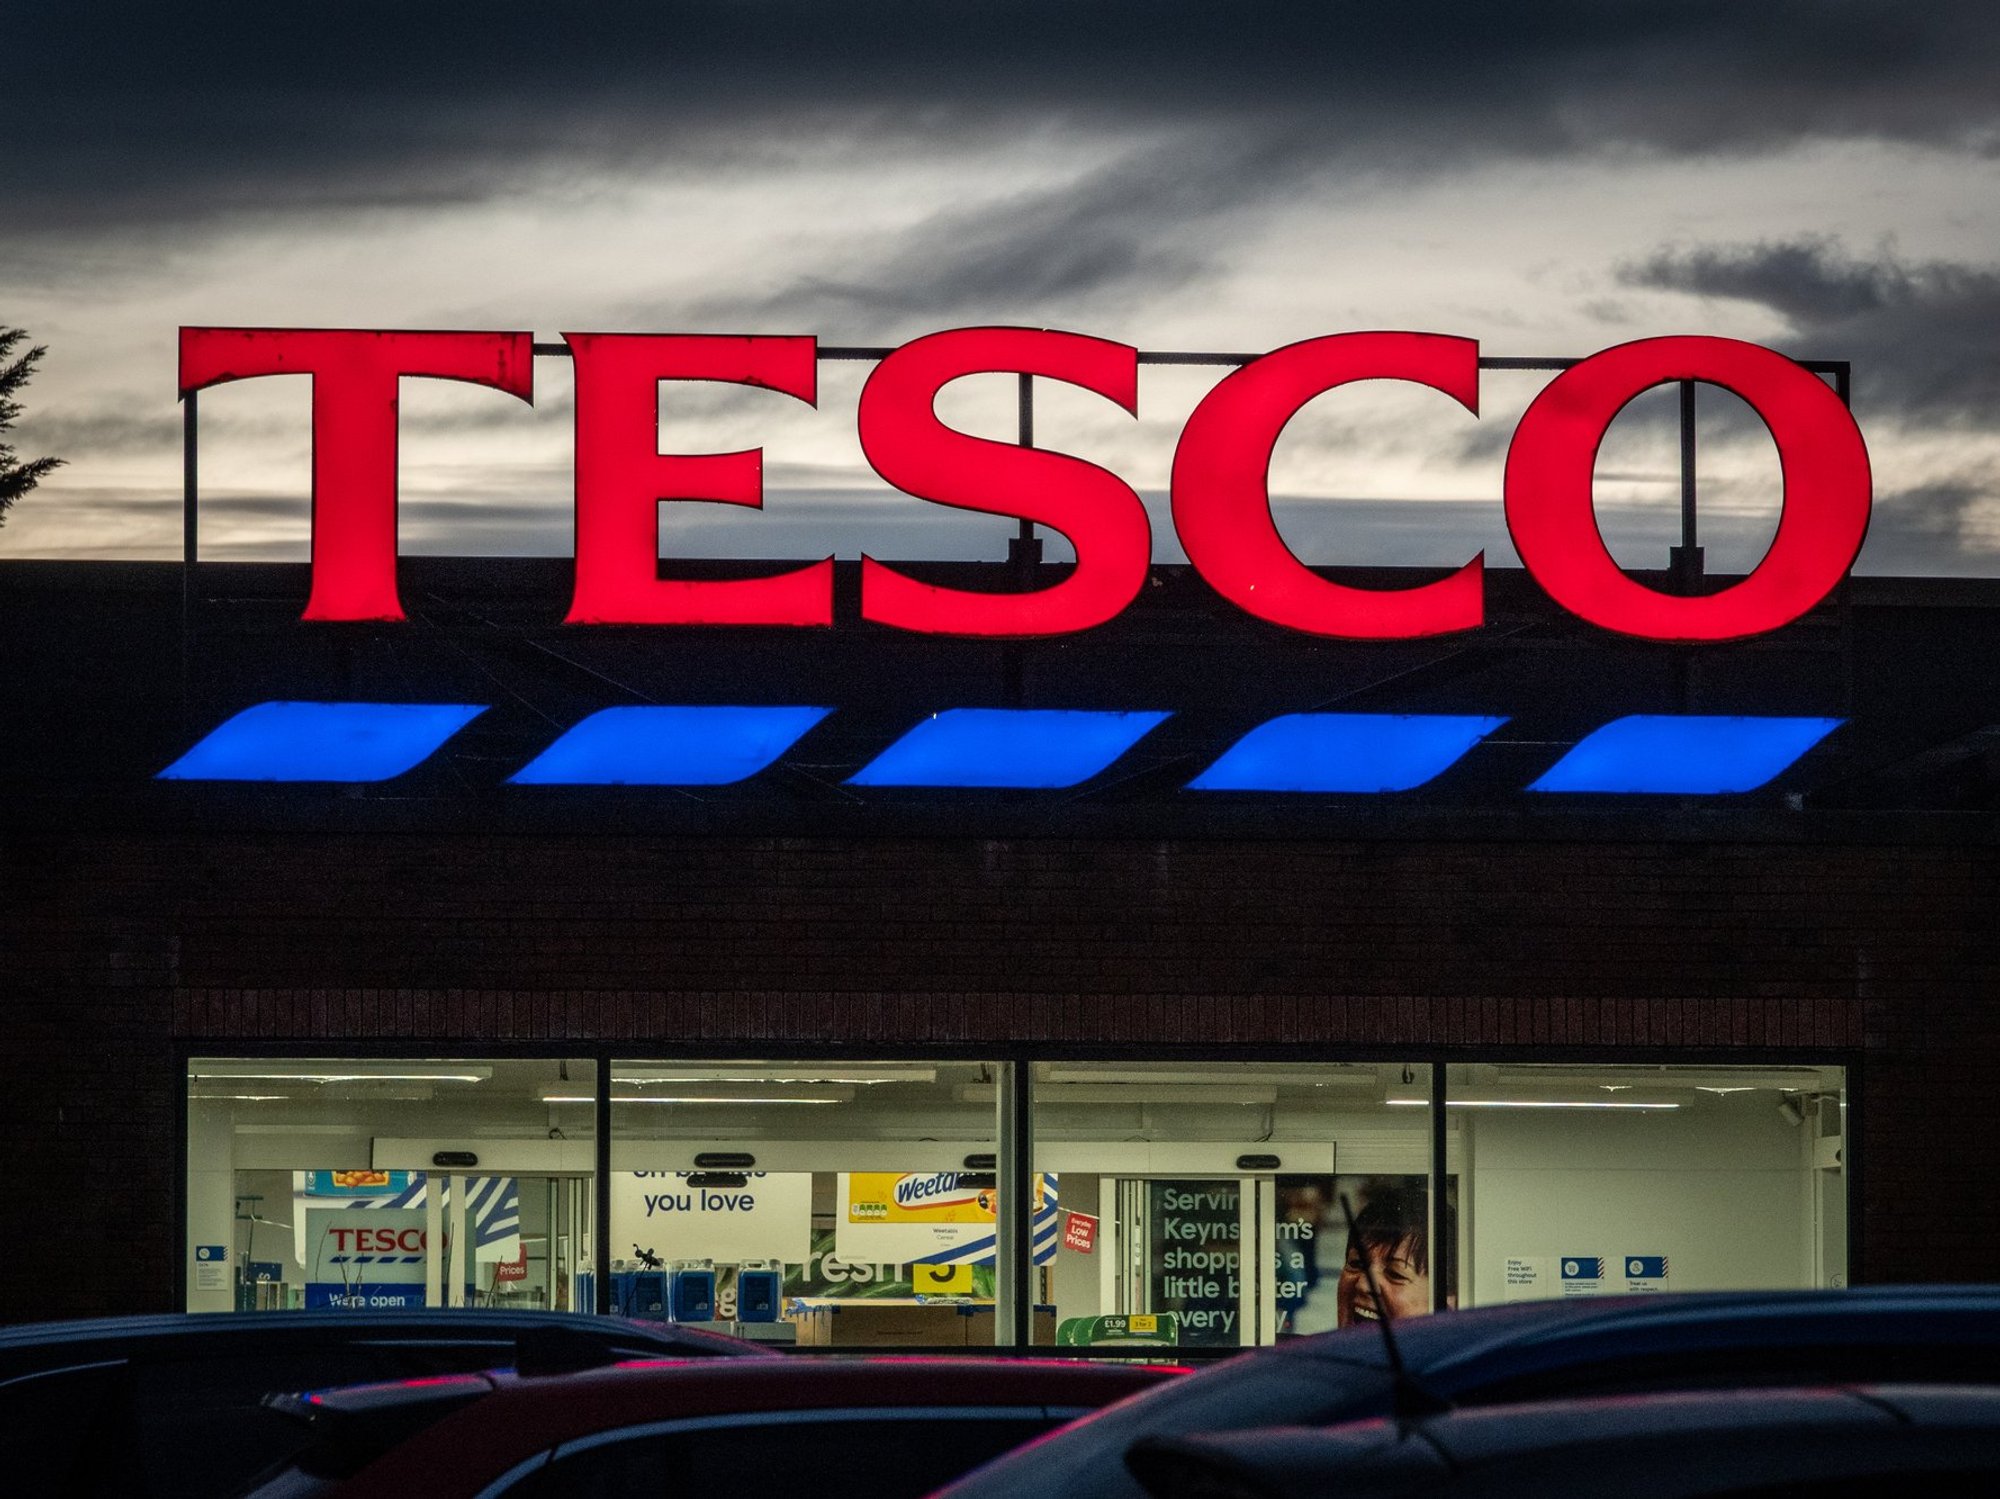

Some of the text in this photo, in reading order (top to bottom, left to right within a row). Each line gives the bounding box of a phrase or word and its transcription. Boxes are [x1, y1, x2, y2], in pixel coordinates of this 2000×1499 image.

[179, 325, 1873, 641] TESCO
[898, 1172, 962, 1204] Weeta
[1164, 1187, 1240, 1211] Servin
[644, 1189, 754, 1217] you love
[329, 1228, 448, 1252] TESCO
[1066, 1234, 1091, 1249] Prices
[1071, 1225, 1089, 1237] Low
[1164, 1217, 1314, 1246] Keynsm's
[500, 1265, 525, 1276] Prices
[1164, 1247, 1305, 1275] shopps a
[1164, 1276, 1308, 1298] little bter
[328, 1293, 406, 1308] Were open
[1104, 1319, 1127, 1328] £1.99
